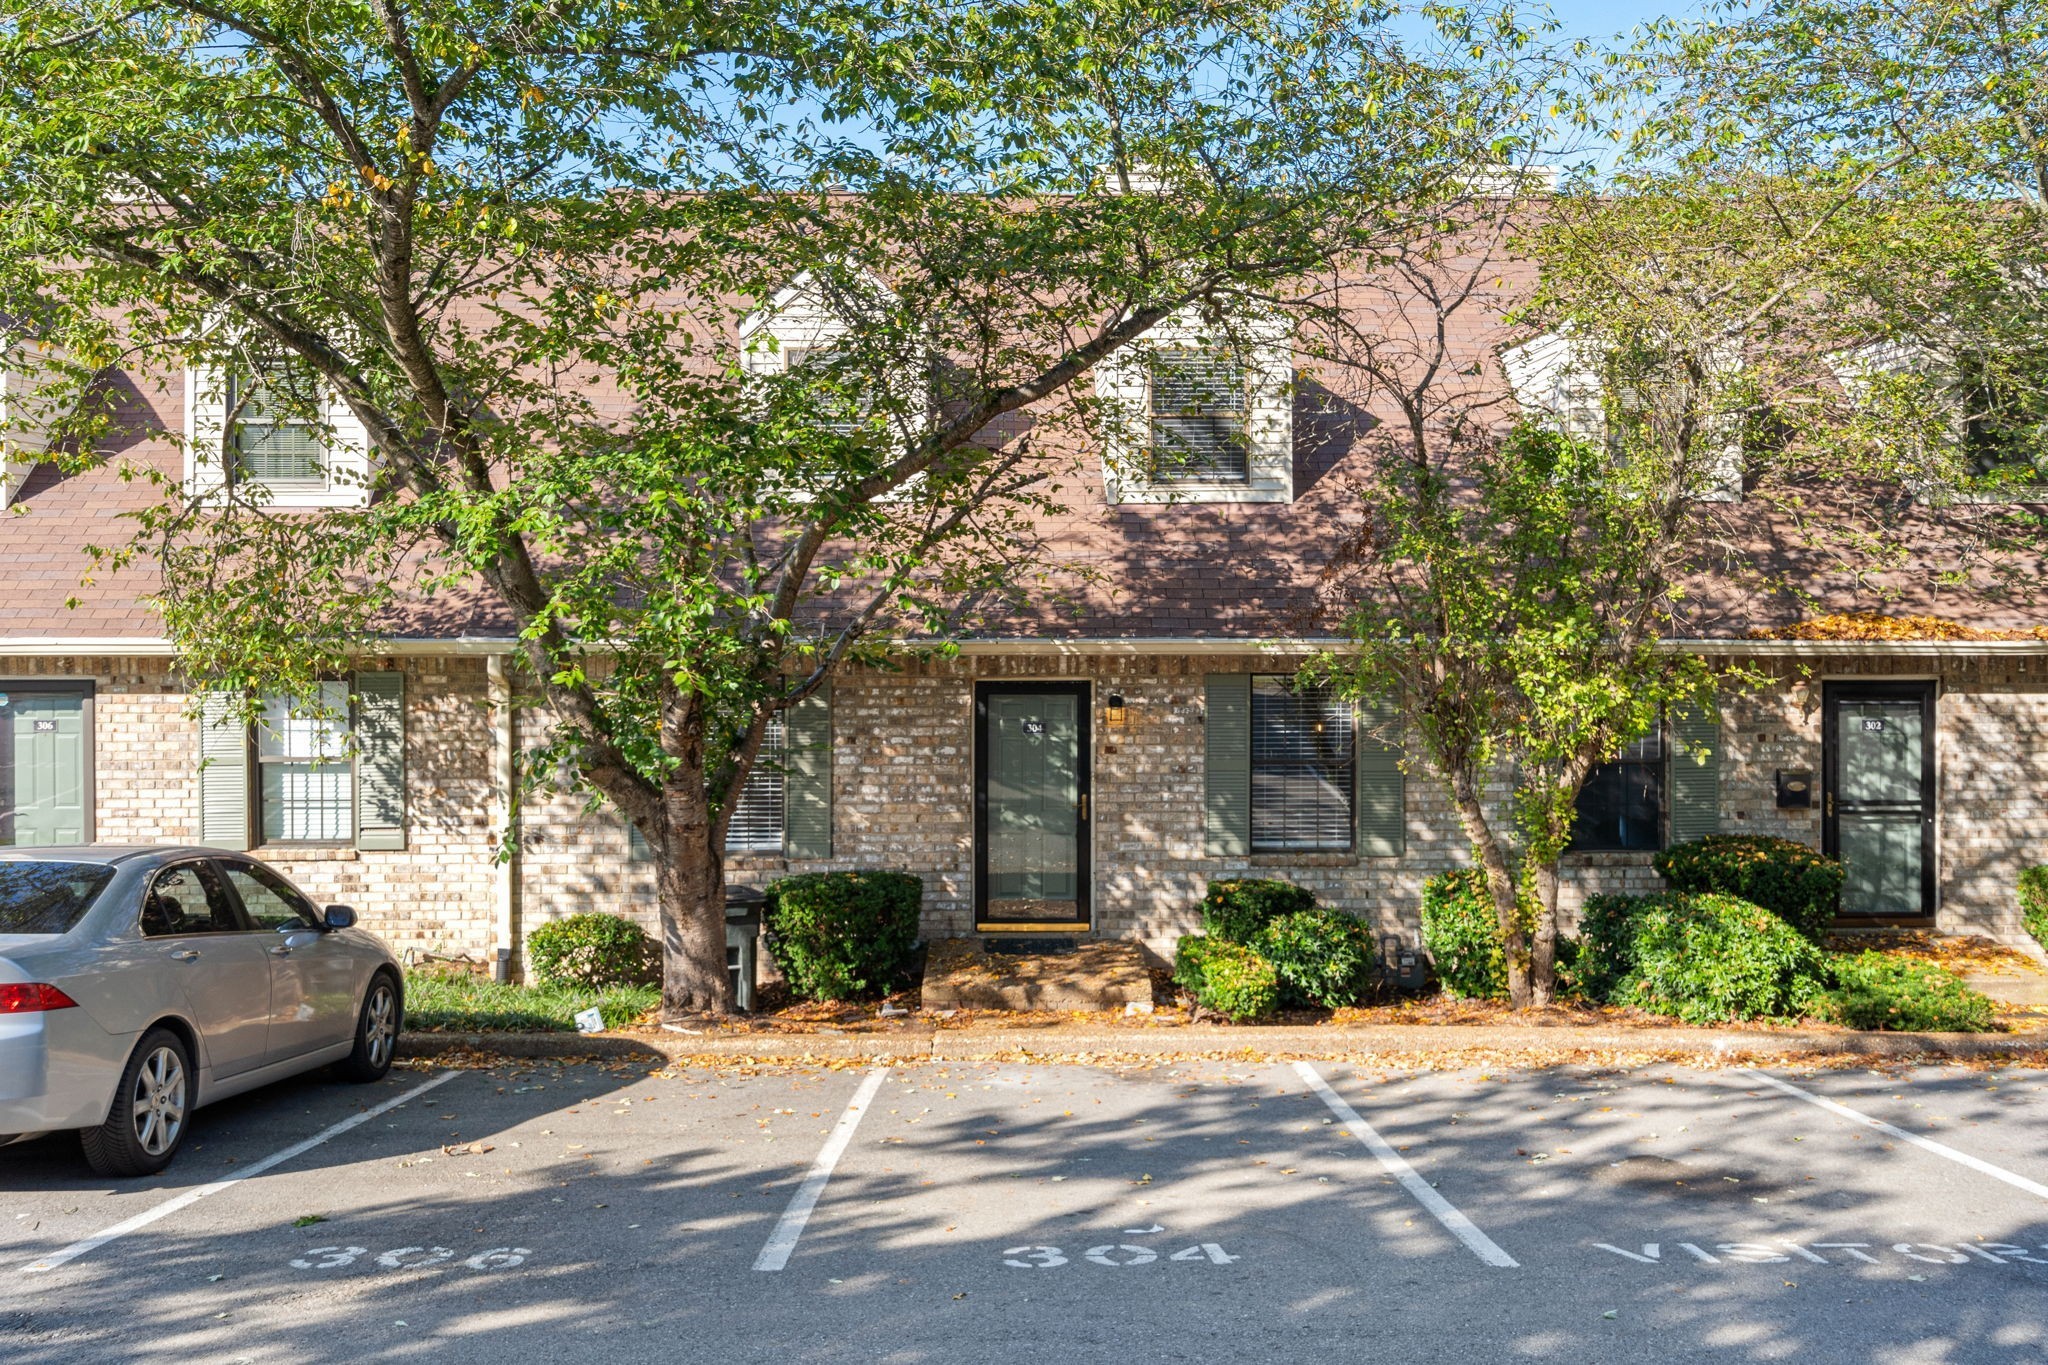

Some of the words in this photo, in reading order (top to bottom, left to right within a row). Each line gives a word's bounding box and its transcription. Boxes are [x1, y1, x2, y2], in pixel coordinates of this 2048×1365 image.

[37, 721, 54, 730] 306
[1865, 721, 1882, 730] 302
[289, 1246, 532, 1269] 306
[1003, 1243, 1241, 1268] 304
